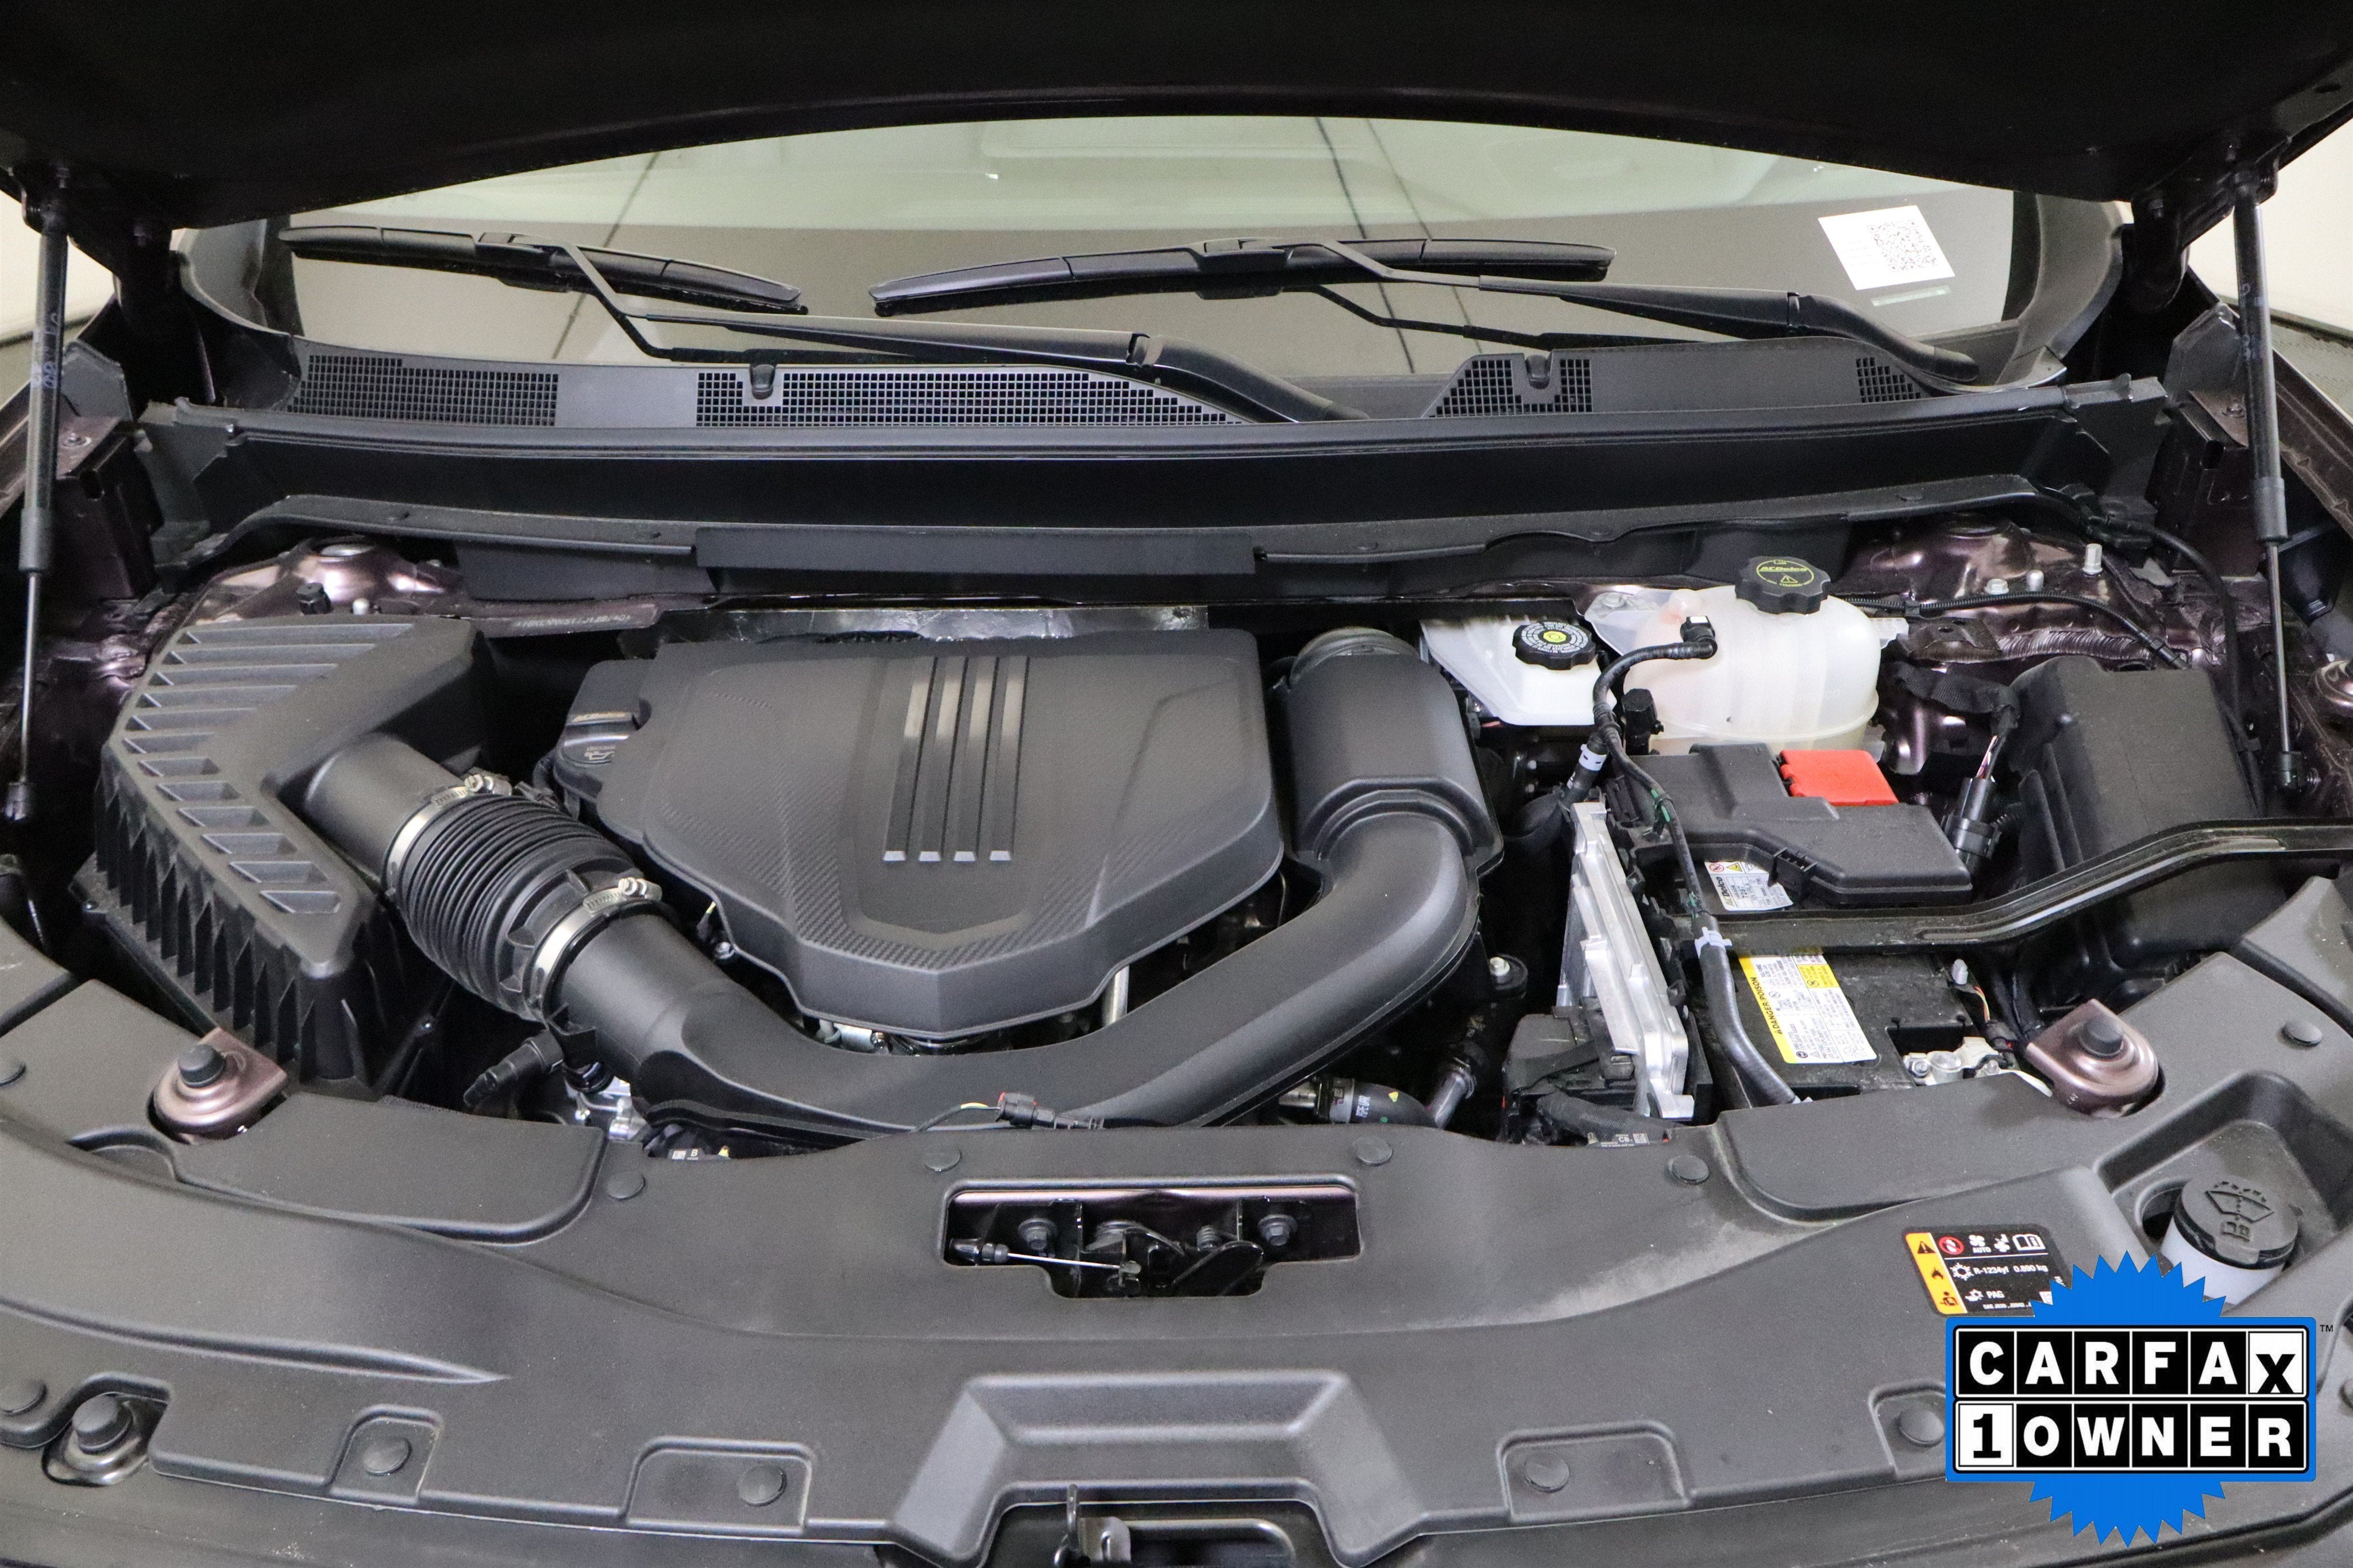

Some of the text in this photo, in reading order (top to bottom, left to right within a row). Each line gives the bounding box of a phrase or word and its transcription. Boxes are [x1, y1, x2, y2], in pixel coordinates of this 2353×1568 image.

[1716, 876, 1734, 907] ACDelco
[1973, 1266, 2009, 1275] R-1234yf
[1986, 1291, 2005, 1299] PAG
